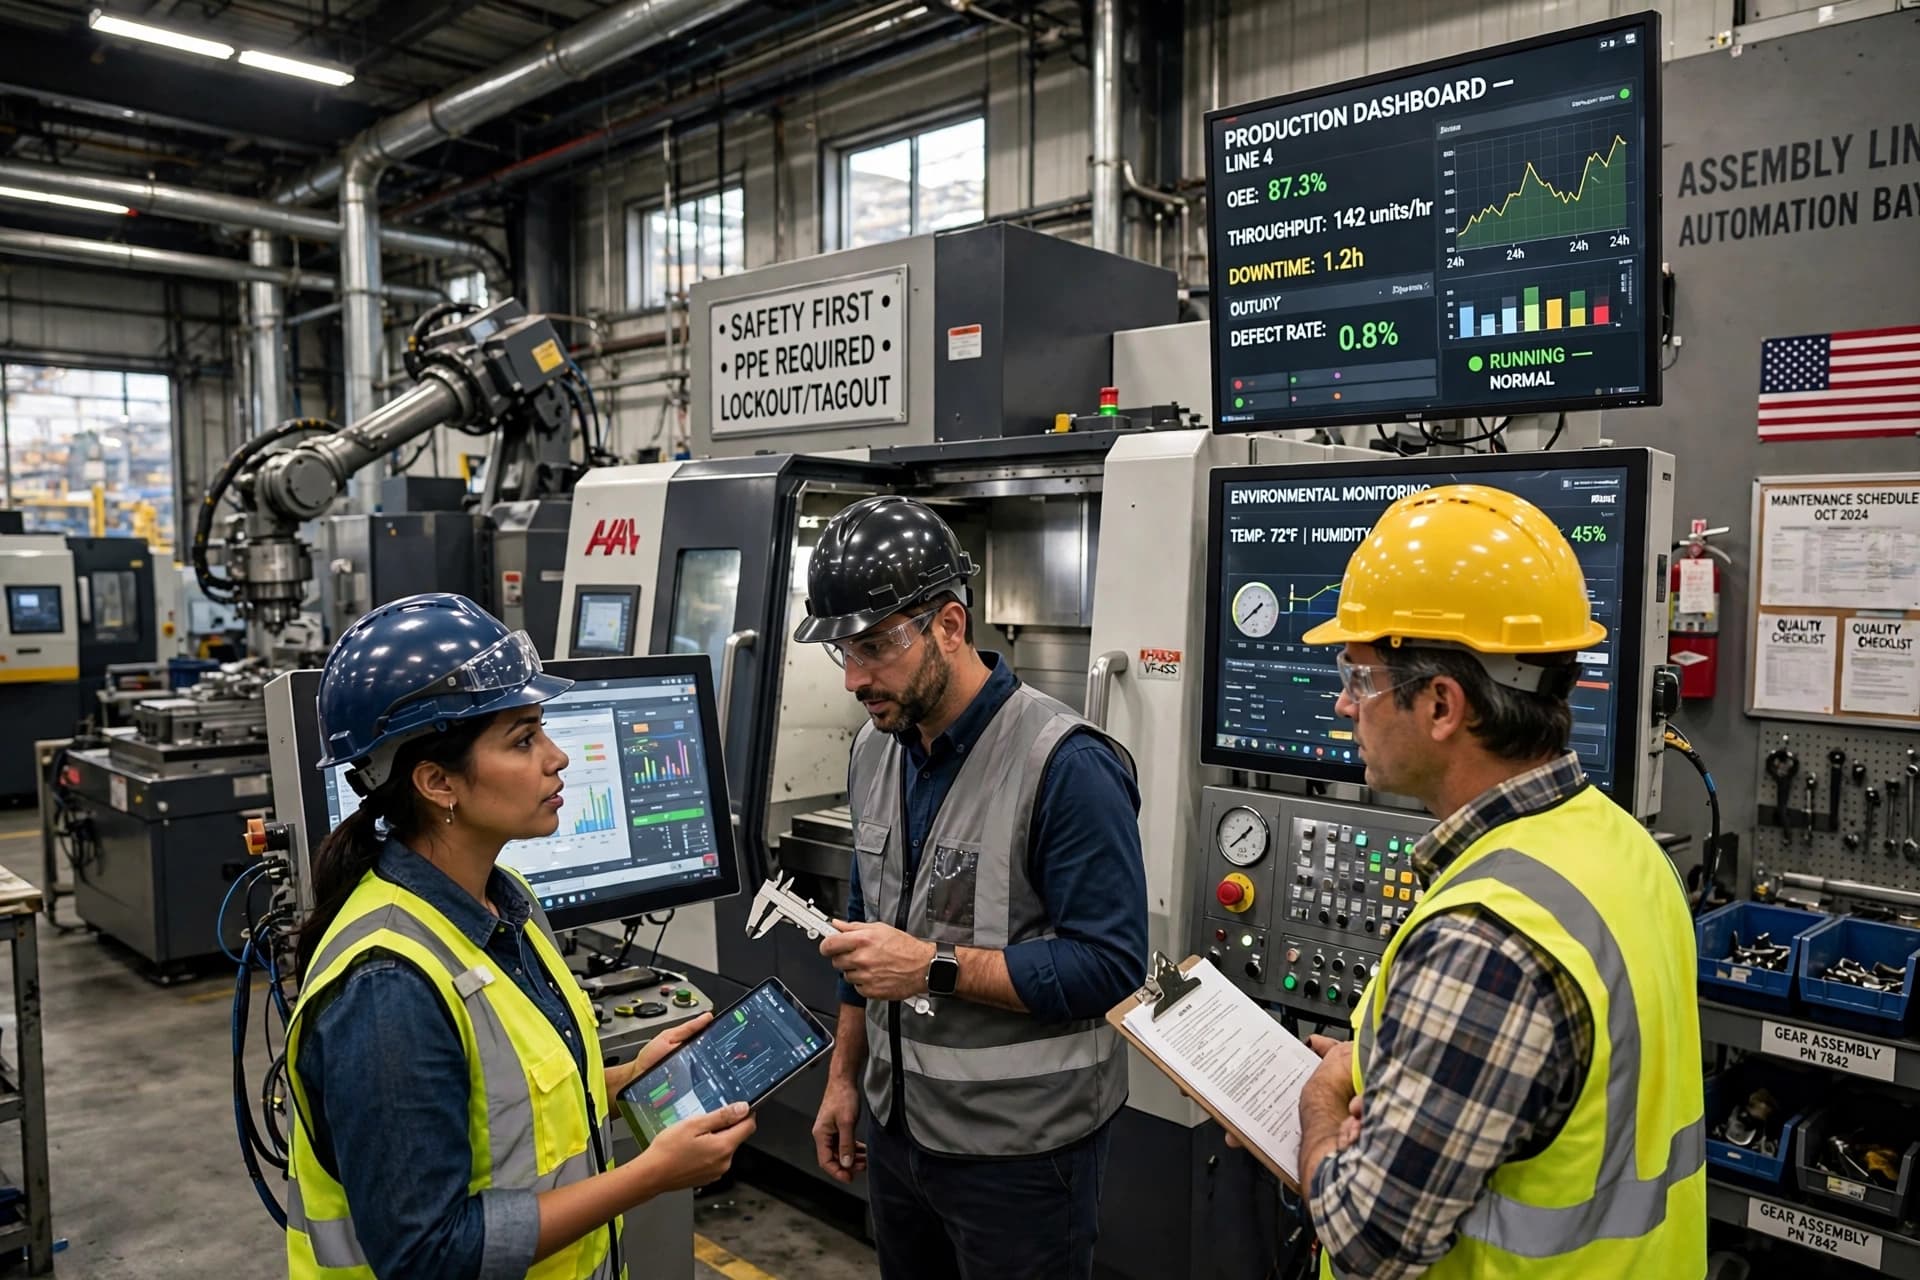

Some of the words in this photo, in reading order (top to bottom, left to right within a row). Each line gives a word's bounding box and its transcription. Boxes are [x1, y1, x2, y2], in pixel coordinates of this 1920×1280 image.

[1225, 106, 1348, 150] PRODUCTION
[1353, 76, 1487, 124] DASHBOARD
[1225, 150, 1260, 173] LINE
[1262, 147, 1273, 165] 4
[1678, 134, 1853, 198] ASSEMBLY
[1227, 187, 1259, 208] OEE:
[1268, 172, 1327, 201] 87.3%
[1227, 215, 1327, 247] THROUGHPUT:
[1333, 206, 1366, 230] 142
[1369, 198, 1434, 224] units/hr
[1679, 191, 1859, 248] AUTOMATION
[1229, 257, 1315, 286] DOWNTIME:
[1323, 246, 1365, 272] 1.2h
[1446, 257, 1465, 269] 24h
[1506, 249, 1525, 261] 24h
[1569, 240, 1589, 252] 24h
[1609, 234, 1630, 248] 24h
[731, 301, 805, 342] SAFETY
[812, 289, 874, 329] FIRST
[1230, 324, 1284, 347] DEFECT
[1286, 320, 1327, 341] RATE:
[1338, 320, 1399, 352] 0.8%
[734, 349, 770, 381] PPE
[775, 334, 876, 376] REQUIRED
[1489, 346, 1566, 370] RUNNING
[1489, 370, 1556, 391] NORMAL
[720, 375, 891, 421] LOCKOUT/TAGOUT
[1230, 487, 1340, 505] ENVIRONMENTAL
[1771, 493, 1853, 507] MAINTENANCE
[1856, 491, 1919, 505] SCHEDULE
[1814, 509, 1838, 521] OCT
[1840, 508, 1869, 521] 2024
[1230, 528, 1266, 544] TEMP:
[1270, 527, 1299, 543] 72°F
[1311, 526, 1372, 543] HUMIDITY
[1571, 525, 1607, 542] 45%
[1771, 632, 1826, 645] CHECKLIST
[1777, 618, 1822, 633] QUALITY
[1852, 623, 1901, 636] QUALITY
[1858, 636, 1913, 650] CHECKLIST
[1774, 1026, 1808, 1044] GEAR
[1811, 1034, 1881, 1061] ASSEMBLY
[1800, 1047, 1817, 1061] PN
[1820, 1052, 1849, 1068] 7842
[1760, 1203, 1795, 1224] GEAR
[1798, 1215, 1870, 1247] ASSEMBLY
[1787, 1227, 1805, 1242] PN
[1808, 1232, 1838, 1252] 7842
